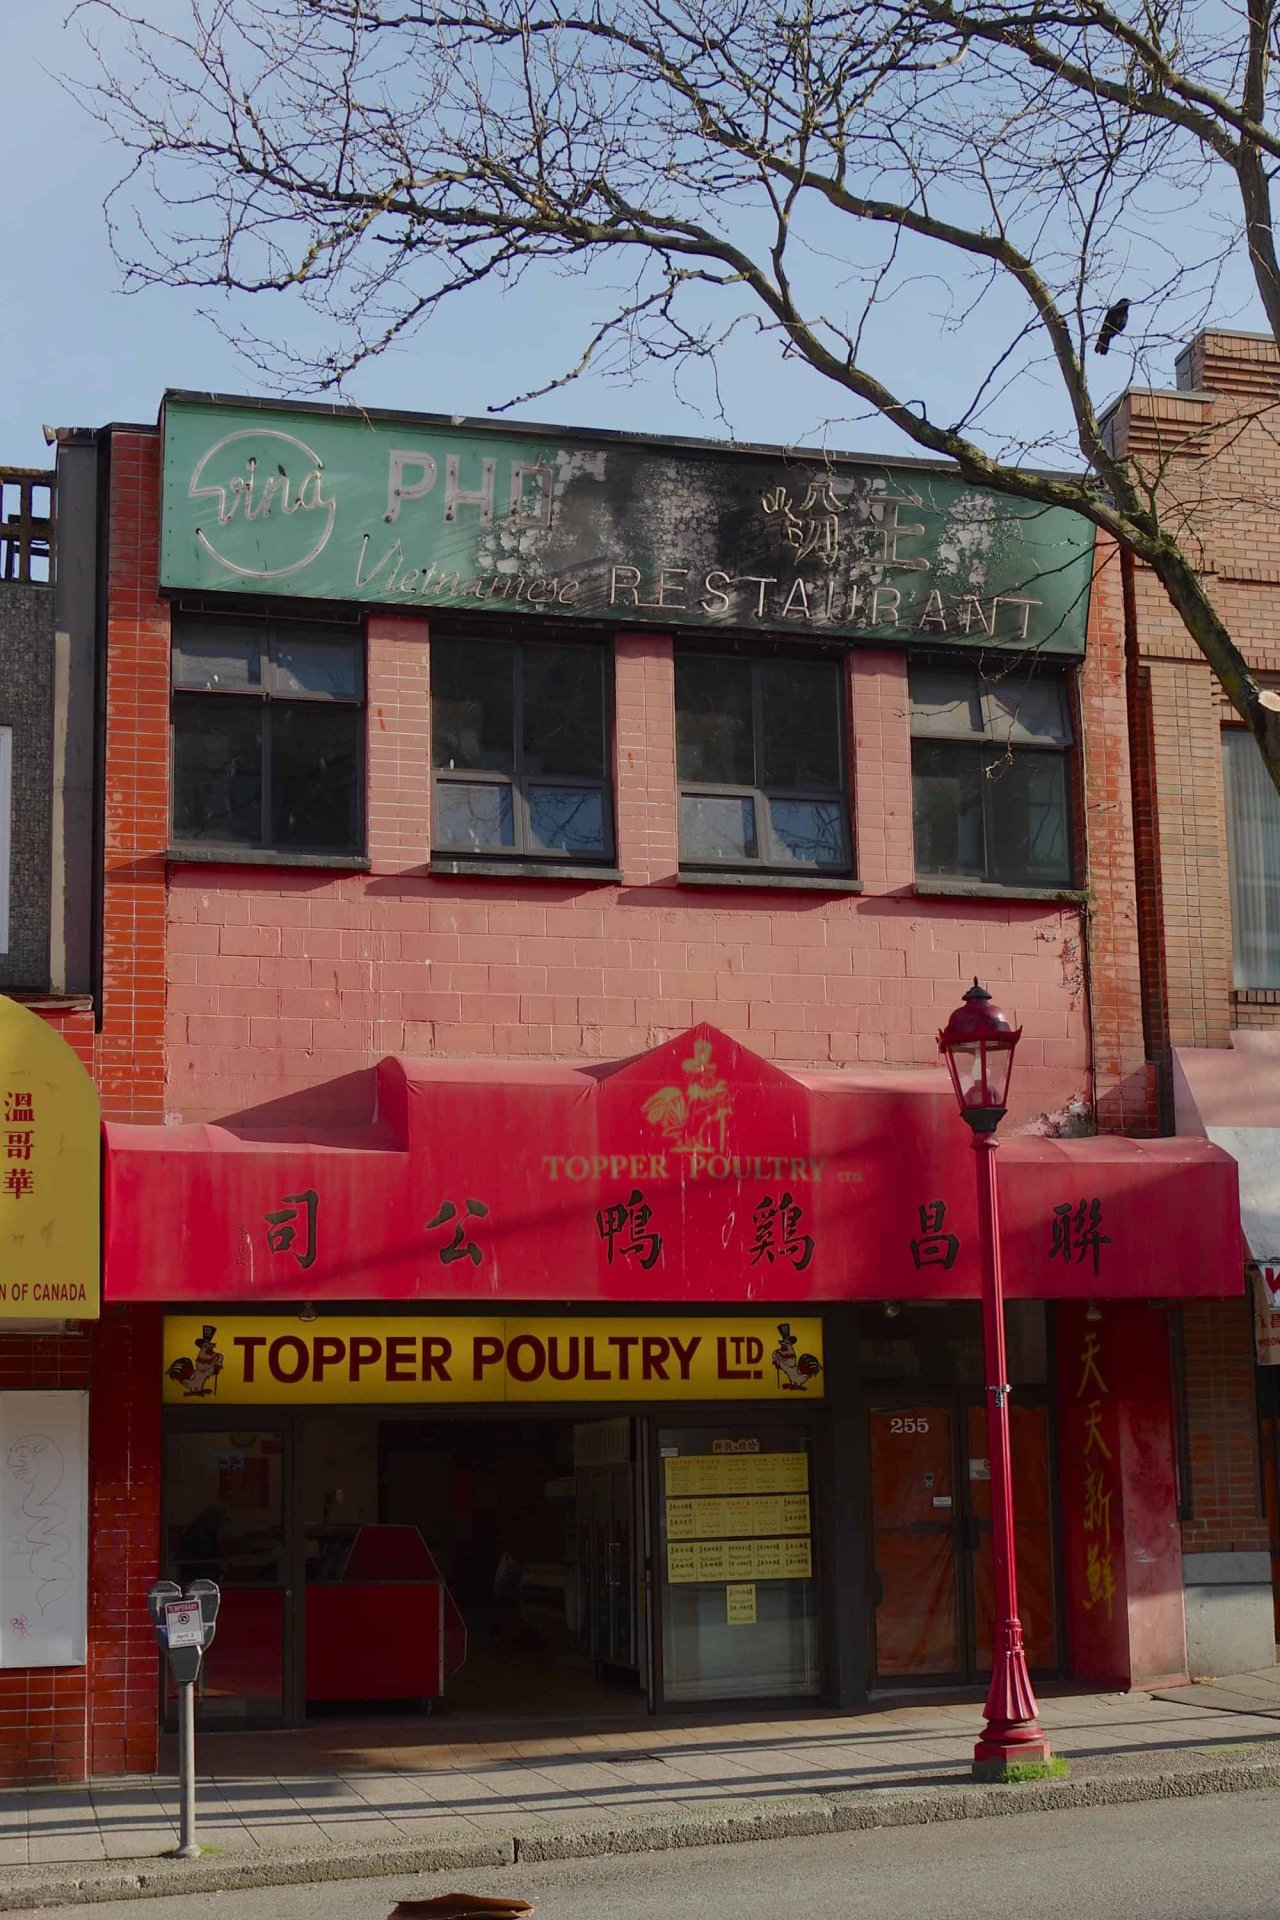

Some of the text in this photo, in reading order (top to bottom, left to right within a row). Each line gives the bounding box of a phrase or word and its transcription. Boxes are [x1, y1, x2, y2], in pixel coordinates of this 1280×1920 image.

[609, 565, 1043, 640] RESTAURANT
[2, 1091, 36, 1200] 溫哥華
[542, 1154, 669, 1181] TOPPER
[688, 1155, 828, 1183] POULTRY
[11, 1283, 29, 1301] OF
[33, 1283, 87, 1301] CANADA
[233, 1336, 455, 1385] TOPPER
[473, 1334, 702, 1384] POULTRY
[890, 1417, 930, 1434] 255
[1076, 1332, 1118, 1622] 天天新鮮
